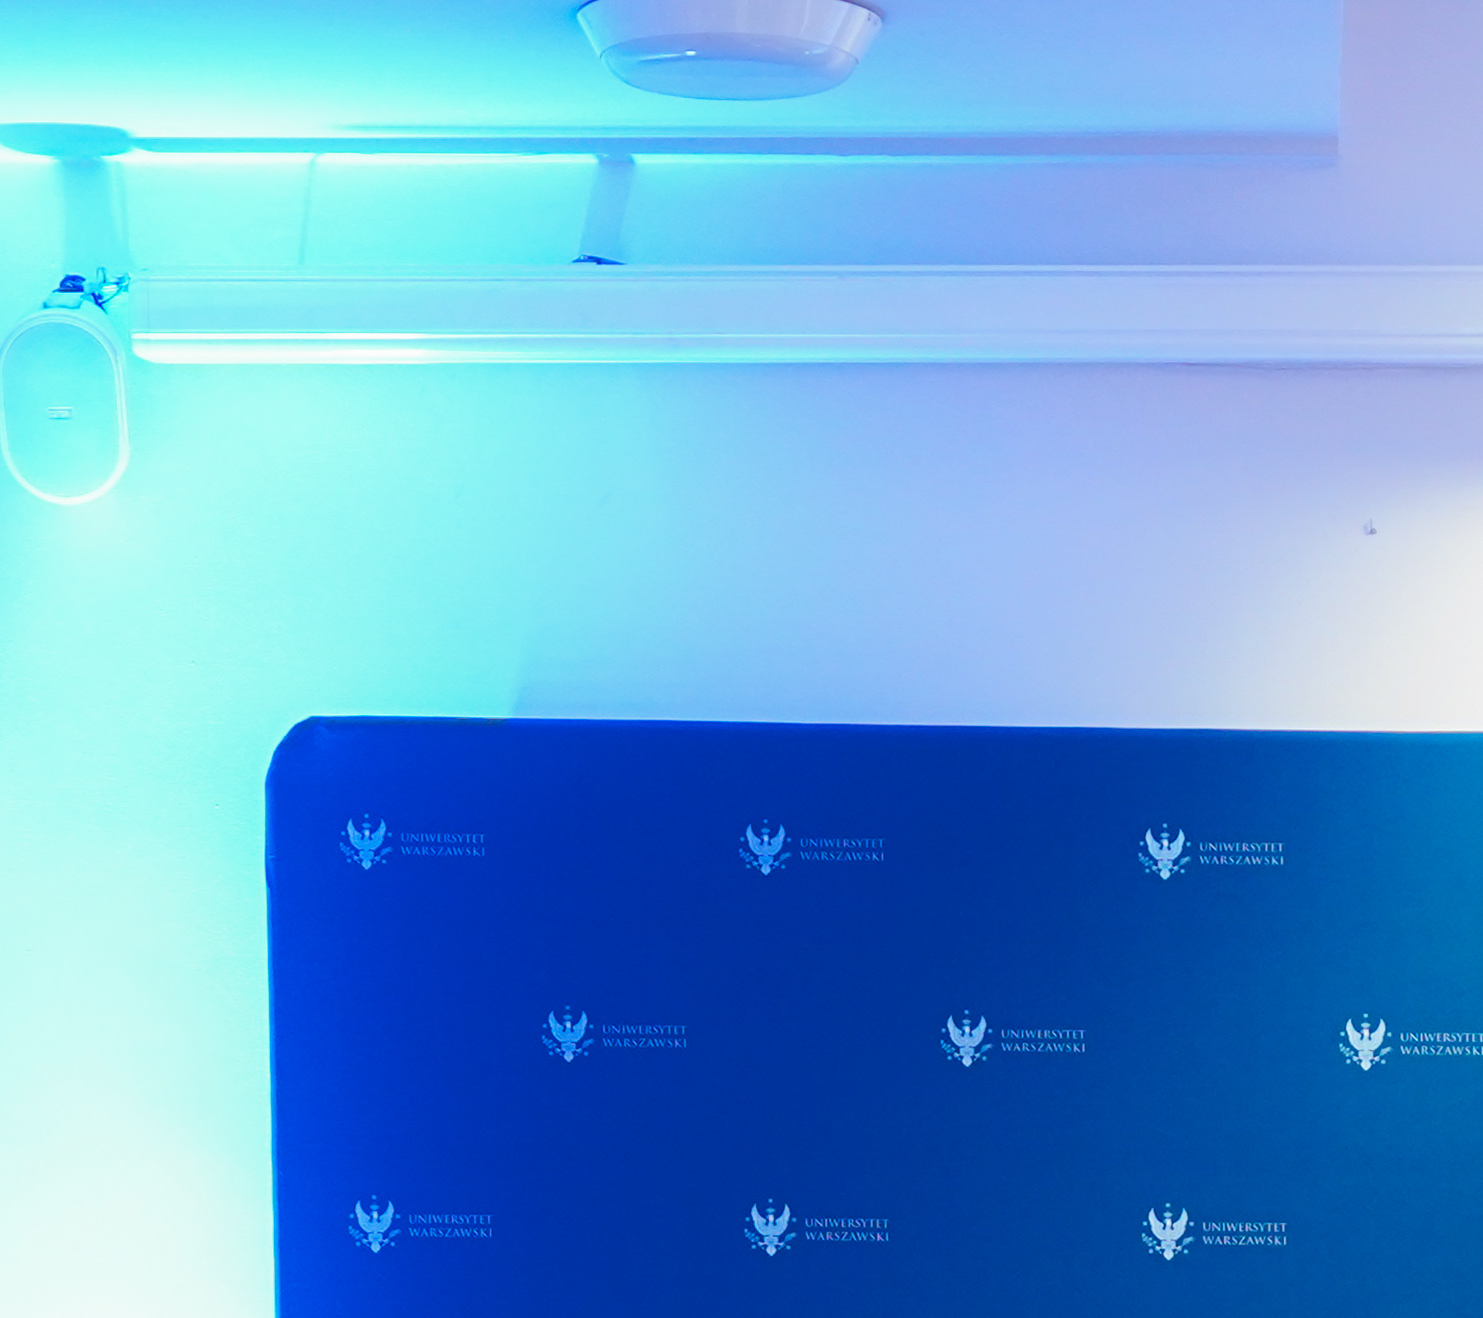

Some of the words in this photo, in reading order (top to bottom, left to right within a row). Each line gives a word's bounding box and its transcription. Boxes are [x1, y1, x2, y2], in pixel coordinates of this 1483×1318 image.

[400, 832, 485, 844] UNIWERSYTET
[800, 838, 883, 849] UNIWERSYTET
[400, 845, 486, 857] WARSZAWSKI
[1199, 842, 1283, 852] UNIWERSYTET
[799, 851, 885, 862] WARSZAWSKI
[1199, 855, 1284, 865] WARSZAWSKI
[602, 1024, 686, 1035] UNIWERSYTET
[1000, 1029, 1084, 1040] UNIWERSYTET
[602, 1037, 687, 1048] WARSZAWSKI
[1399, 1032, 1483, 1043] UNIWERSYTET
[1001, 1042, 1086, 1053] WARSZAWSKI
[408, 1214, 491, 1225] UNIWERSYTET
[804, 1218, 888, 1229] UNIWERSYTET
[408, 1227, 493, 1238] WARSZAWSKI
[1202, 1222, 1287, 1233] UNIWERSYTET
[805, 1231, 889, 1242] WARSZAWSKI
[1202, 1235, 1287, 1246] WARSZAWSKI
